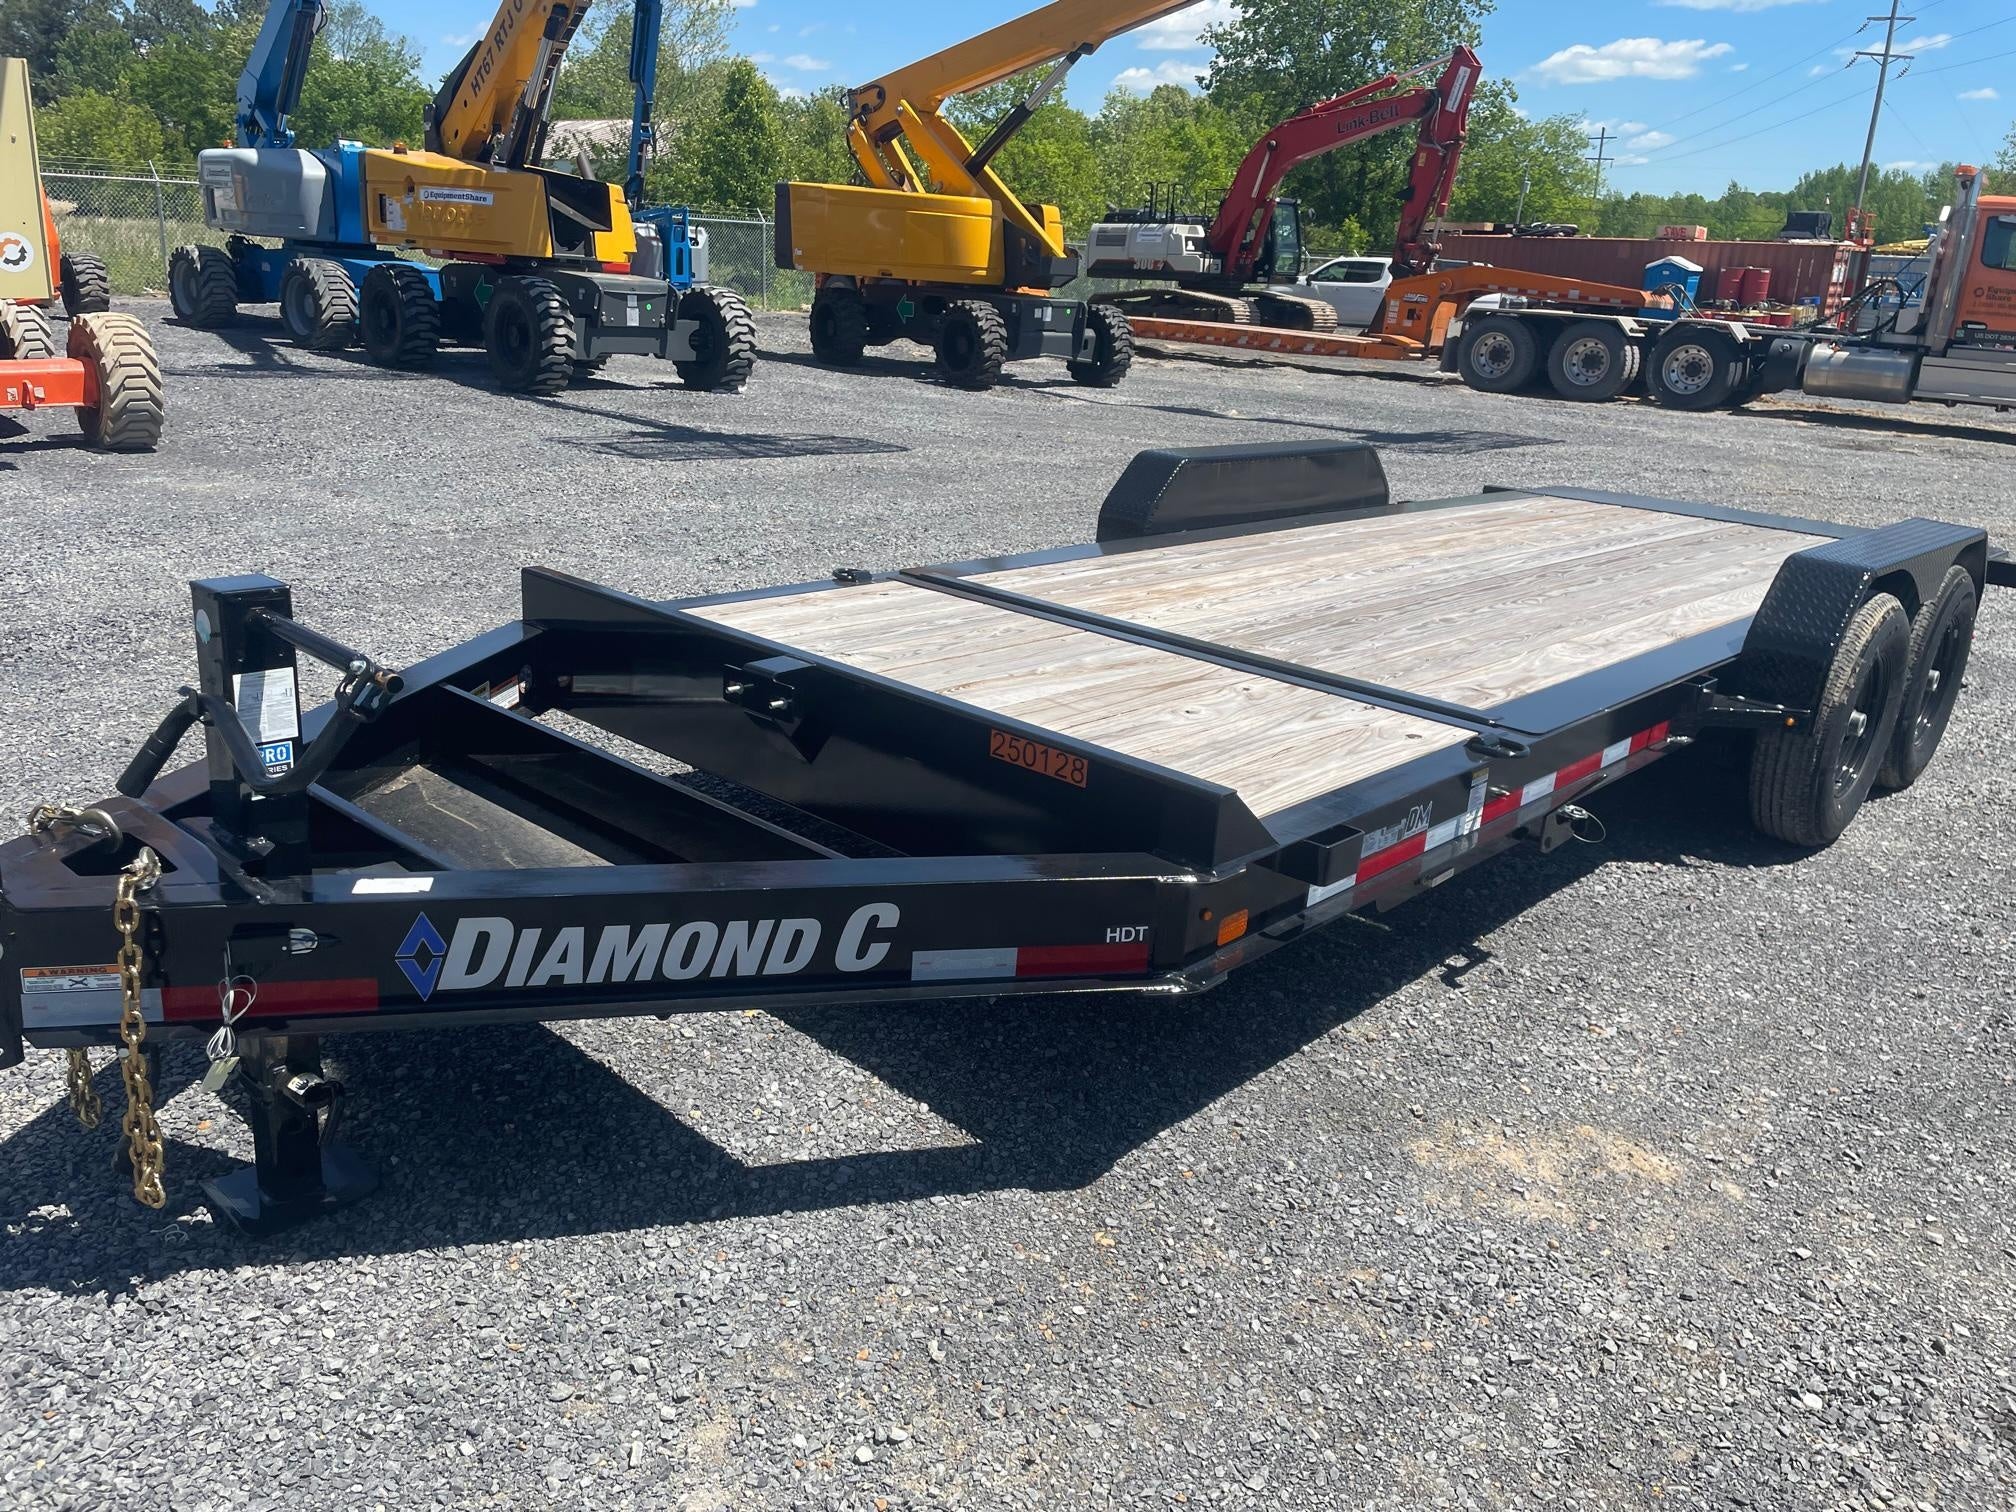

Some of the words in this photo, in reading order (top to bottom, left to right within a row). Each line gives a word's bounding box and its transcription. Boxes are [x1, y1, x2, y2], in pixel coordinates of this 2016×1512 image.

[471, 46, 495, 97] HT67
[494, 9, 514, 52] RTJ
[1337, 104, 1399, 134] Link-Belt
[429, 191, 488, 202] EquipmentShare
[992, 732, 1085, 784] 250128
[437, 916, 822, 991] DIAMOND
[835, 902, 900, 973] C
[1106, 926, 1149, 943] HDT
[49, 966, 108, 976] WARNING
